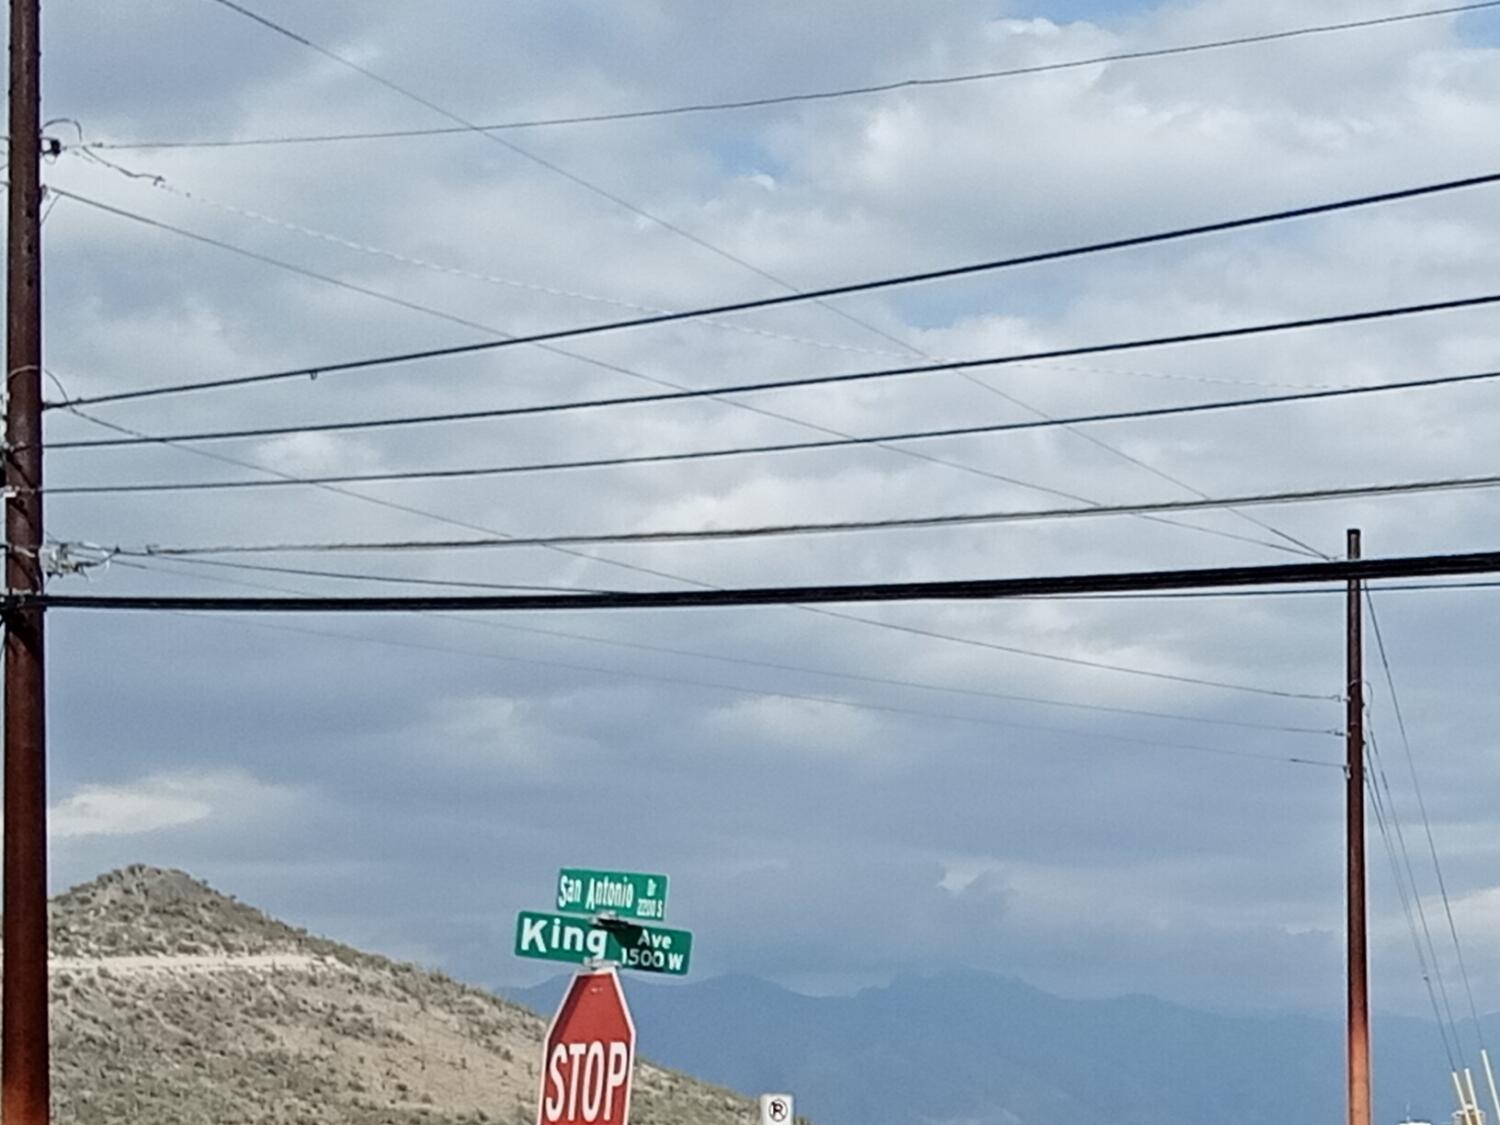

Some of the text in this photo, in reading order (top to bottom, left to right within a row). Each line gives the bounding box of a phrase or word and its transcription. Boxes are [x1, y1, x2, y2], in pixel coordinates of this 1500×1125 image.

[558, 875, 634, 909] San Antonio
[520, 917, 608, 960] King
[637, 929, 672, 949] Ave
[621, 947, 684, 971] 1500 W
[545, 1041, 628, 1123] STOP
